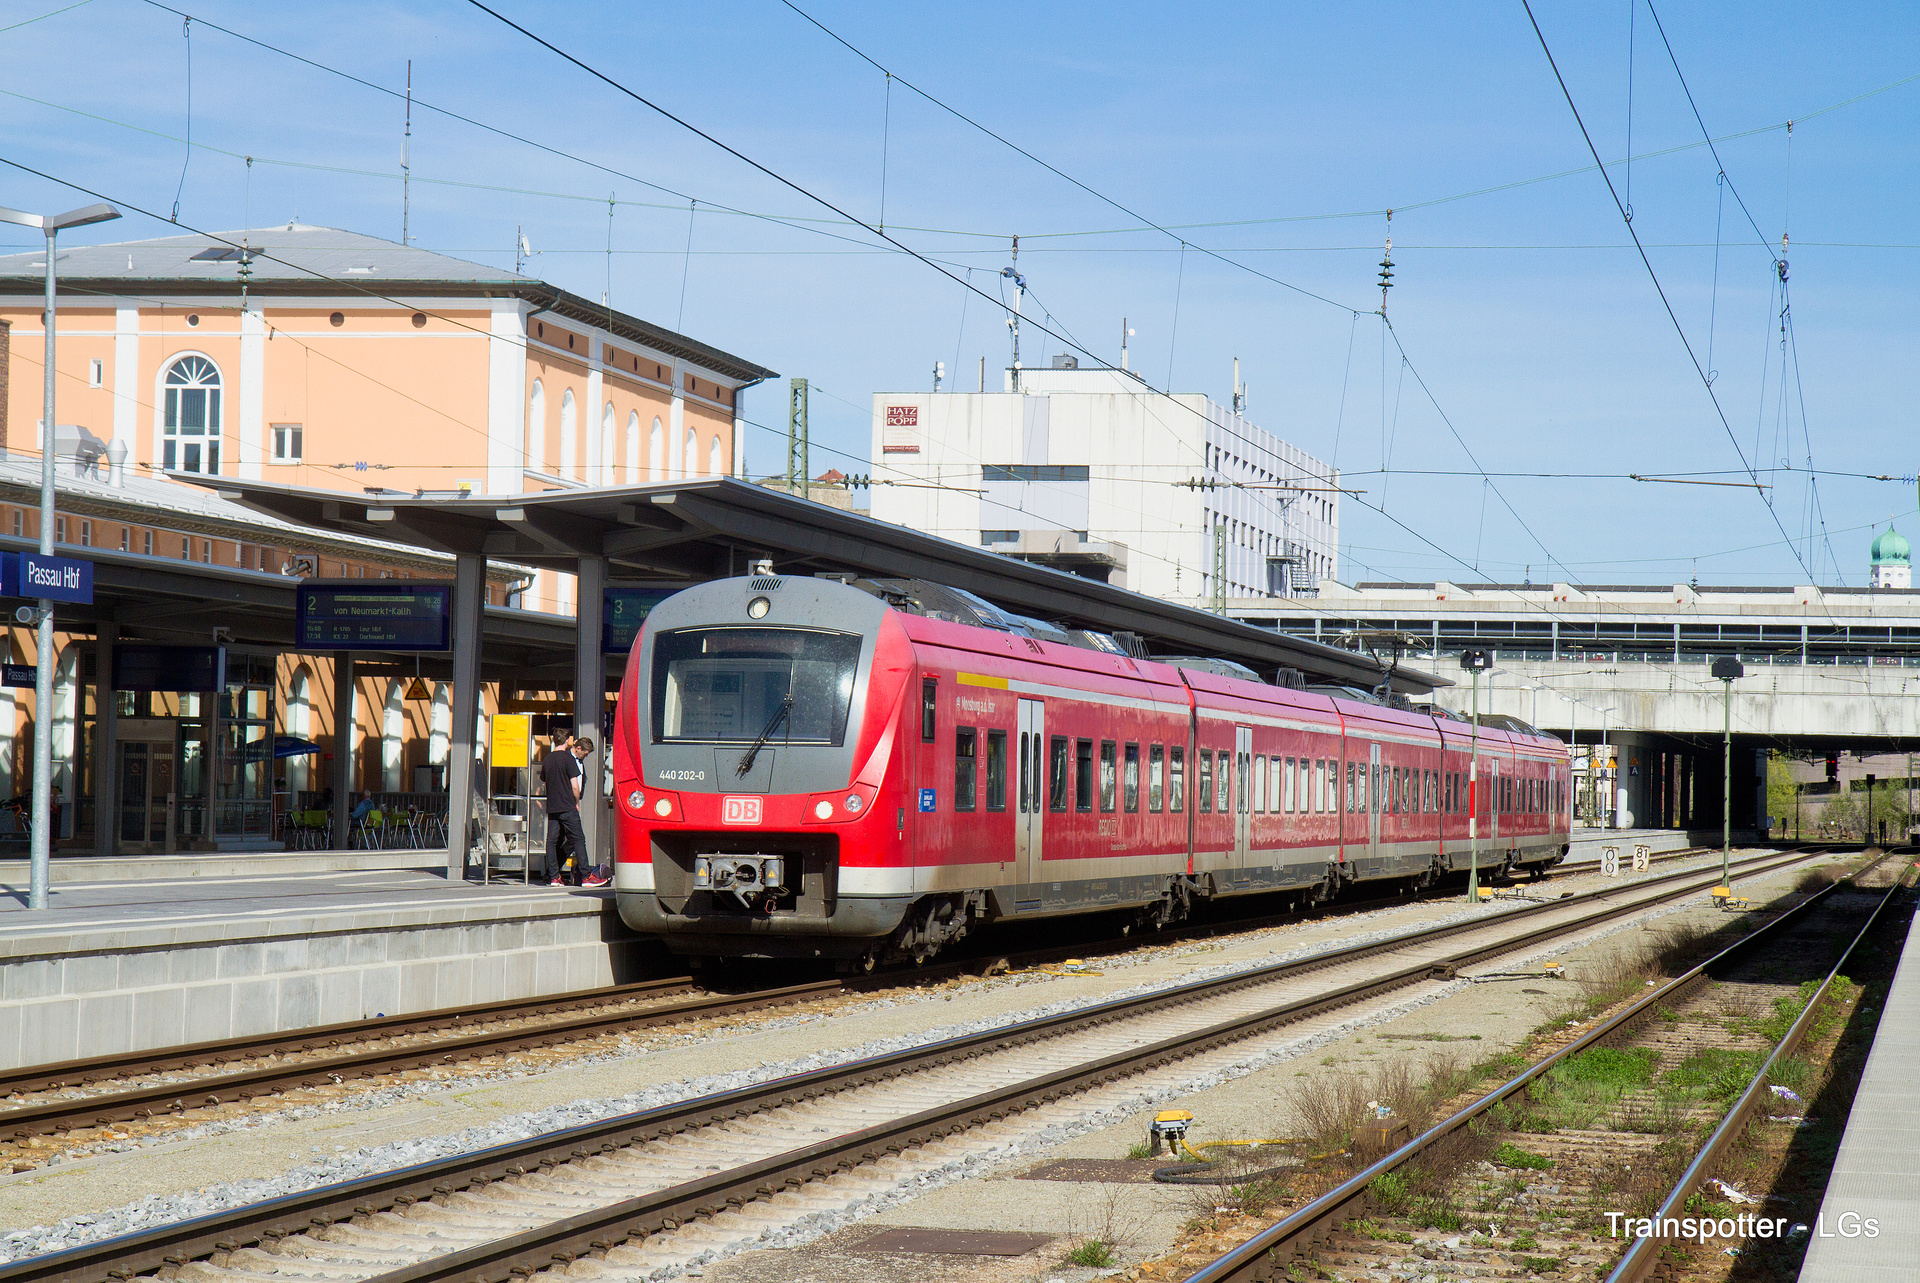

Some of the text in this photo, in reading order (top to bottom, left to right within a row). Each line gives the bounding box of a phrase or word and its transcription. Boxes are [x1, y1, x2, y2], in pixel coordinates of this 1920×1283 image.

[28, 561, 80, 589] Passau Hbf
[307, 596, 316, 610] 2
[614, 600, 622, 614] 3
[7, 668, 37, 682] Passau Hb
[1070, 738, 1074, 761] 2
[660, 770, 705, 780] 440 202-0
[726, 800, 758, 820] DB
[1636, 848, 1648, 858] 81
[1638, 860, 1644, 870] 2
